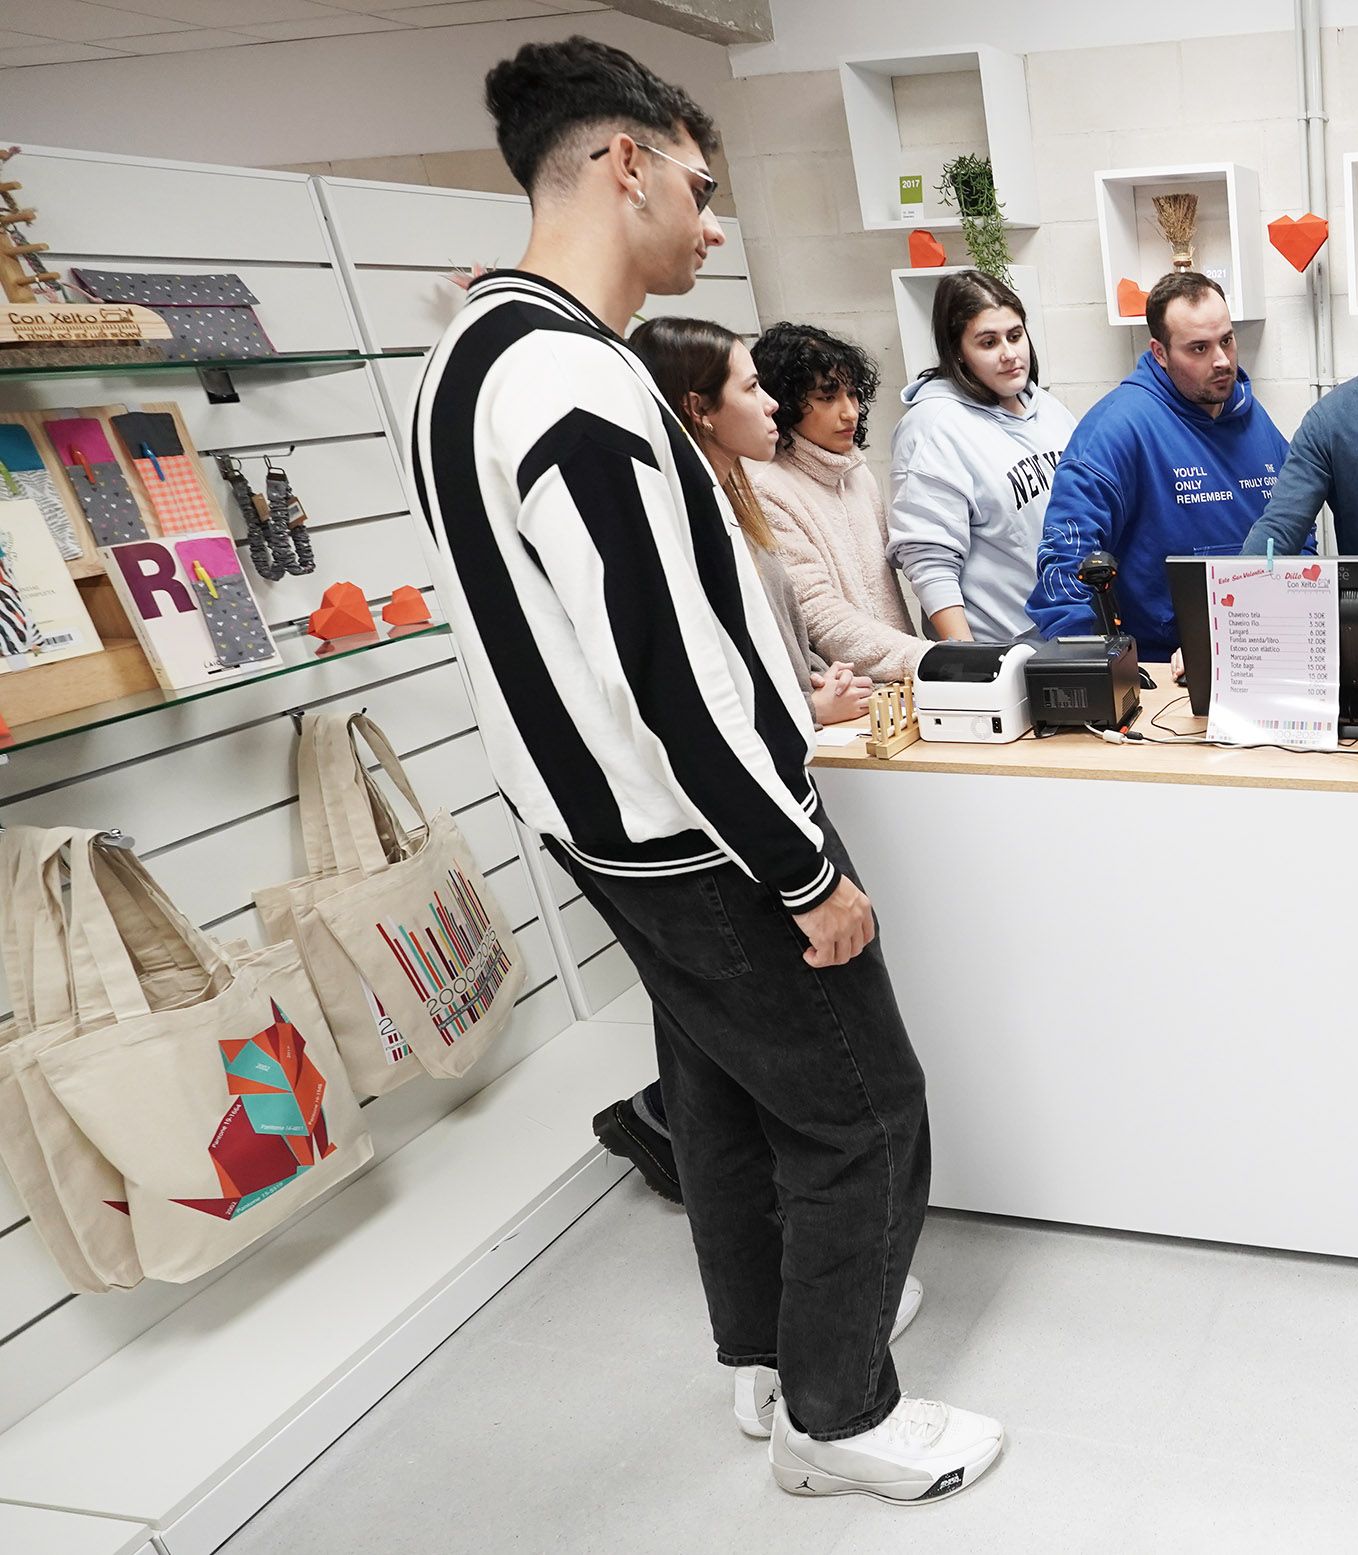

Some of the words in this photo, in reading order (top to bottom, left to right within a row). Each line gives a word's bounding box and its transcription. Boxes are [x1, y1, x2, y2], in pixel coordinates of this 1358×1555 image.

[902, 179, 920, 188] 2017
[1206, 269, 1226, 278] 2021
[8, 312, 46, 325] Con
[1173, 467, 1207, 478] YOU'LL
[1264, 464, 1275, 473] THE
[1006, 454, 1050, 511] NEW
[1174, 480, 1202, 492] ONLY
[1239, 478, 1263, 490] TRULY
[1176, 491, 1234, 504] REMEMBER
[111, 542, 198, 620] R
[1287, 580, 1299, 588] Con
[426, 925, 497, 1017] 2000-2025
[211, 1124, 228, 1149] Pantone
